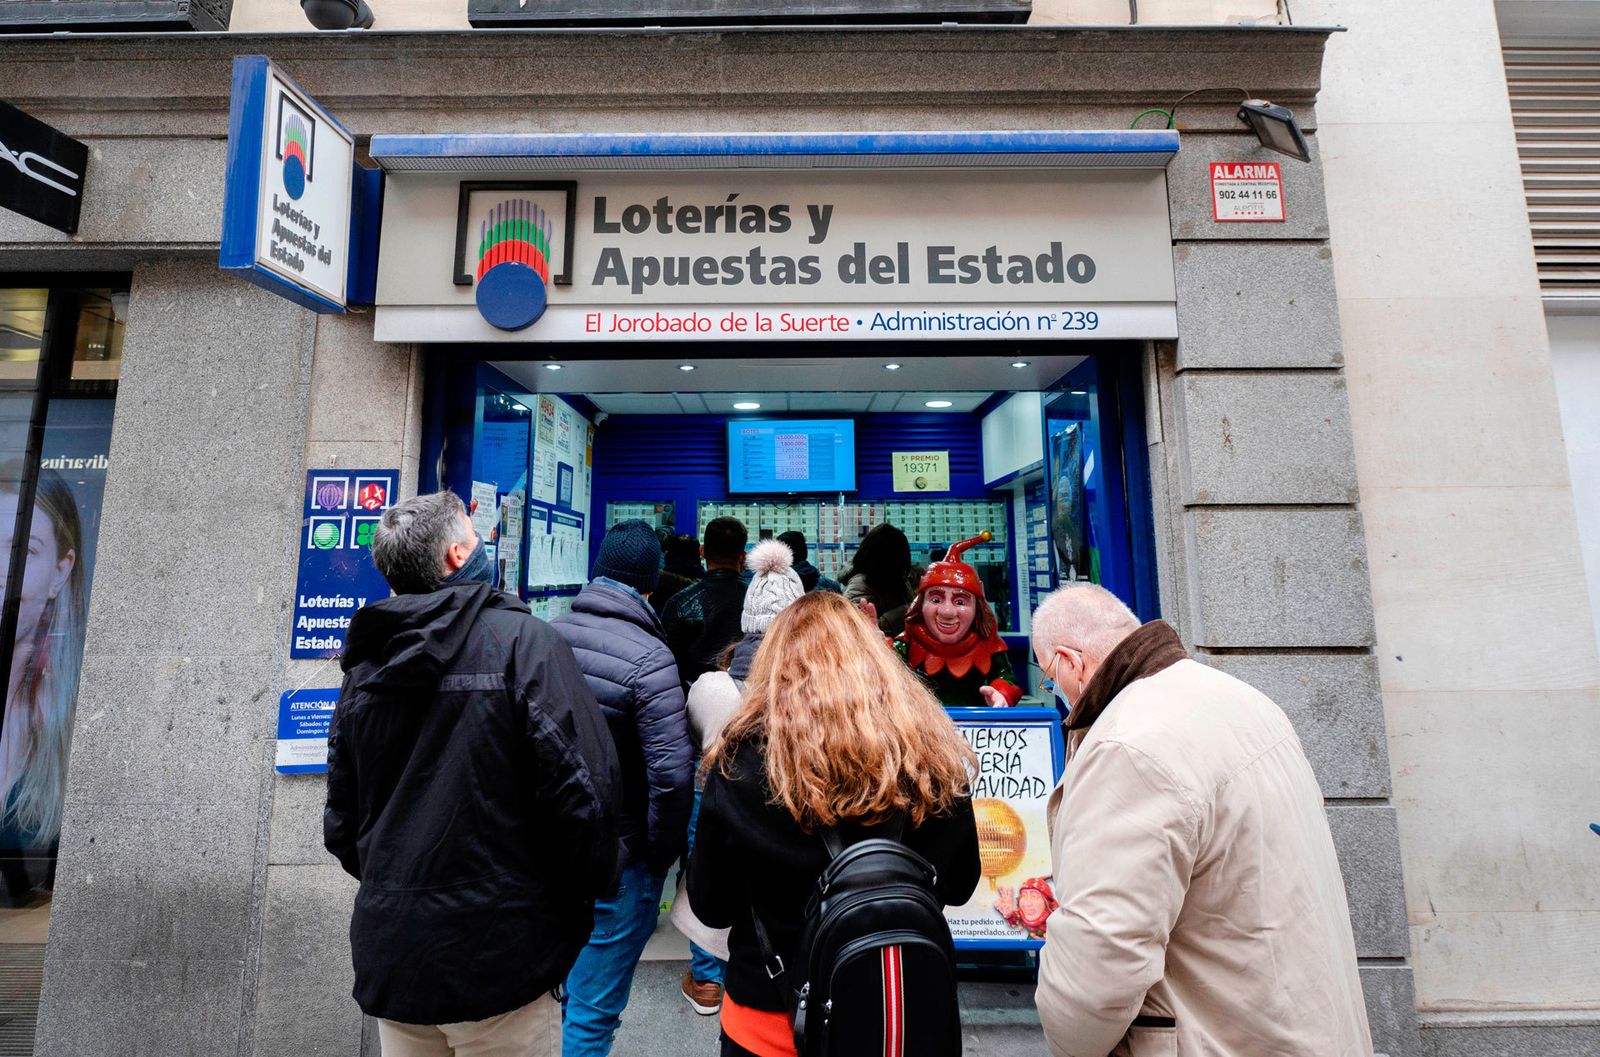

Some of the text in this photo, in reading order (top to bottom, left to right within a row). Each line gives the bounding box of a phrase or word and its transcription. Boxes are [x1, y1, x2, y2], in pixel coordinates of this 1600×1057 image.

[1214, 165, 1278, 179] ALARMA
[1219, 190, 1278, 200] 902 44 11 66
[273, 193, 321, 241] Loterías y
[593, 193, 834, 244] Loterías y
[272, 217, 332, 266] Apuestas del
[270, 240, 305, 273] Estado
[592, 241, 1097, 295] Apuestas del Estado
[585, 313, 601, 333] El
[608, 312, 712, 333] Jorobado
[720, 312, 748, 332] de
[755, 312, 773, 332] la
[780, 312, 850, 332] Suerte
[870, 310, 1031, 332] Administración
[1062, 311, 1099, 331] 239
[903, 462, 938, 473] 19371
[299, 594, 367, 610] Loterías y
[296, 615, 352, 632] Apuesta
[295, 635, 343, 650] Estado
[290, 700, 330, 710] ATENCIÓN
[962, 728, 1028, 751] NEMOS
[970, 918, 994, 926] pedido
